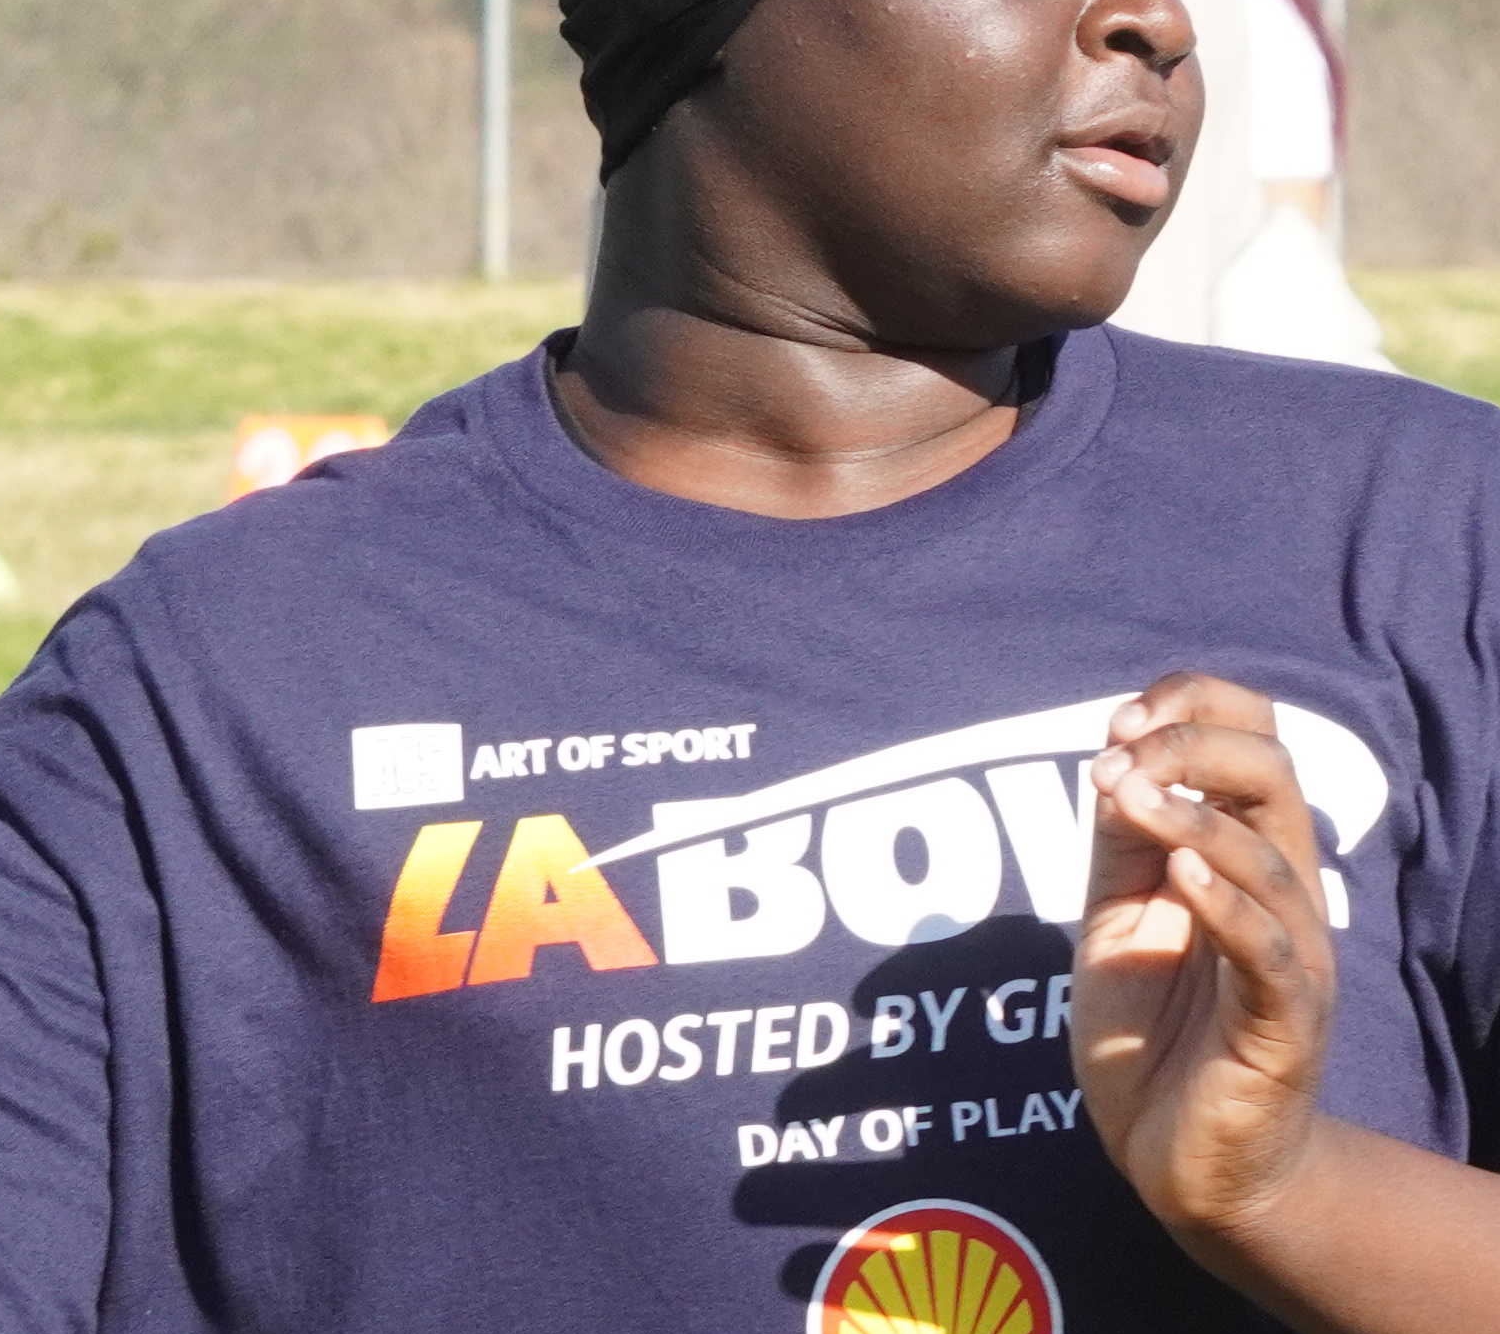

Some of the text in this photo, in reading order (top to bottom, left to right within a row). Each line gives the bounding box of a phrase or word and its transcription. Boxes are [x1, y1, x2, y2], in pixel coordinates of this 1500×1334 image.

[468, 722, 758, 781] ART OF SPORT
[371, 812, 661, 1004] LA
[550, 1000, 850, 1093] HOSTED
[870, 986, 969, 1060] BY
[736, 1087, 1083, 1168] DAY OF PLAY
